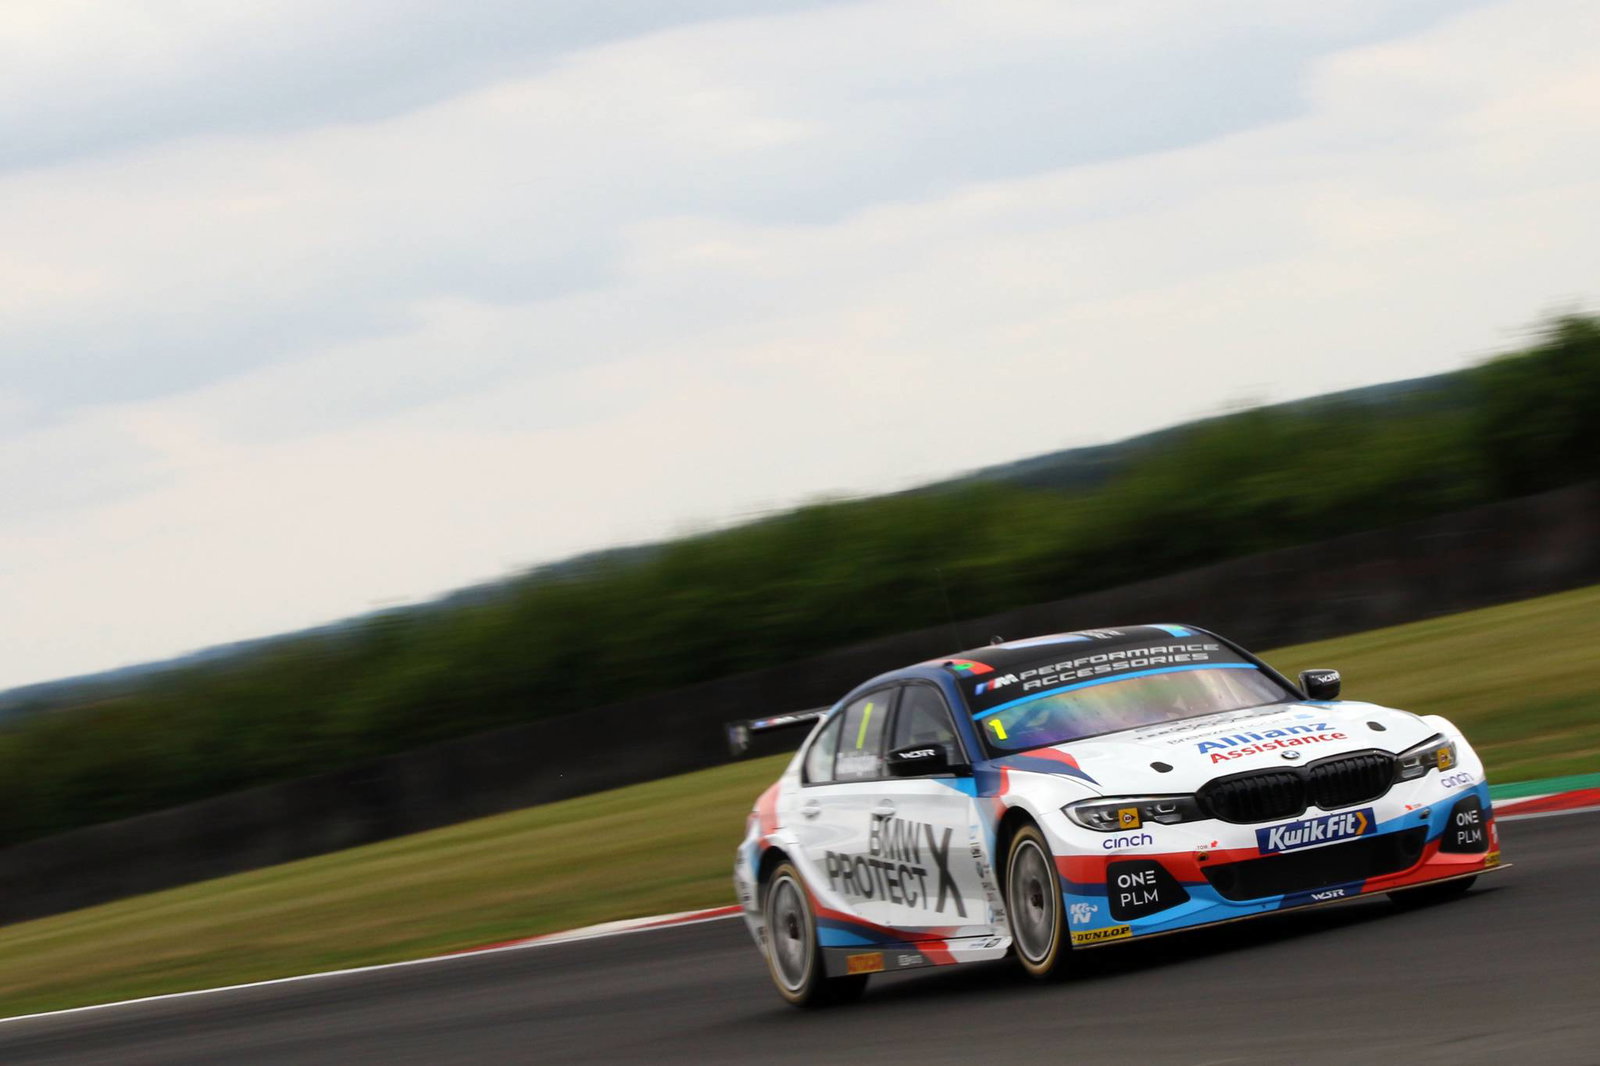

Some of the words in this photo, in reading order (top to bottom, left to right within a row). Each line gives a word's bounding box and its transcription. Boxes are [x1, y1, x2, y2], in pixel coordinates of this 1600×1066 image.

[1020, 643, 1219, 680] PERFORMANCE
[1023, 652, 1209, 691] ACCESSORIES
[988, 719, 1008, 740] 1
[1194, 721, 1336, 754] Allianz
[1210, 732, 1348, 764] Assistance
[1441, 772, 1474, 788] cinch
[1456, 810, 1479, 826] ONE
[870, 814, 921, 864] BMW
[1103, 833, 1153, 850] cinch
[1457, 829, 1481, 845] PLM
[826, 850, 927, 910] PROTECT
[924, 823, 968, 919] X
[1118, 870, 1157, 888] ONE
[1121, 889, 1159, 907] PLM
[1077, 926, 1130, 942] DUNLOP
